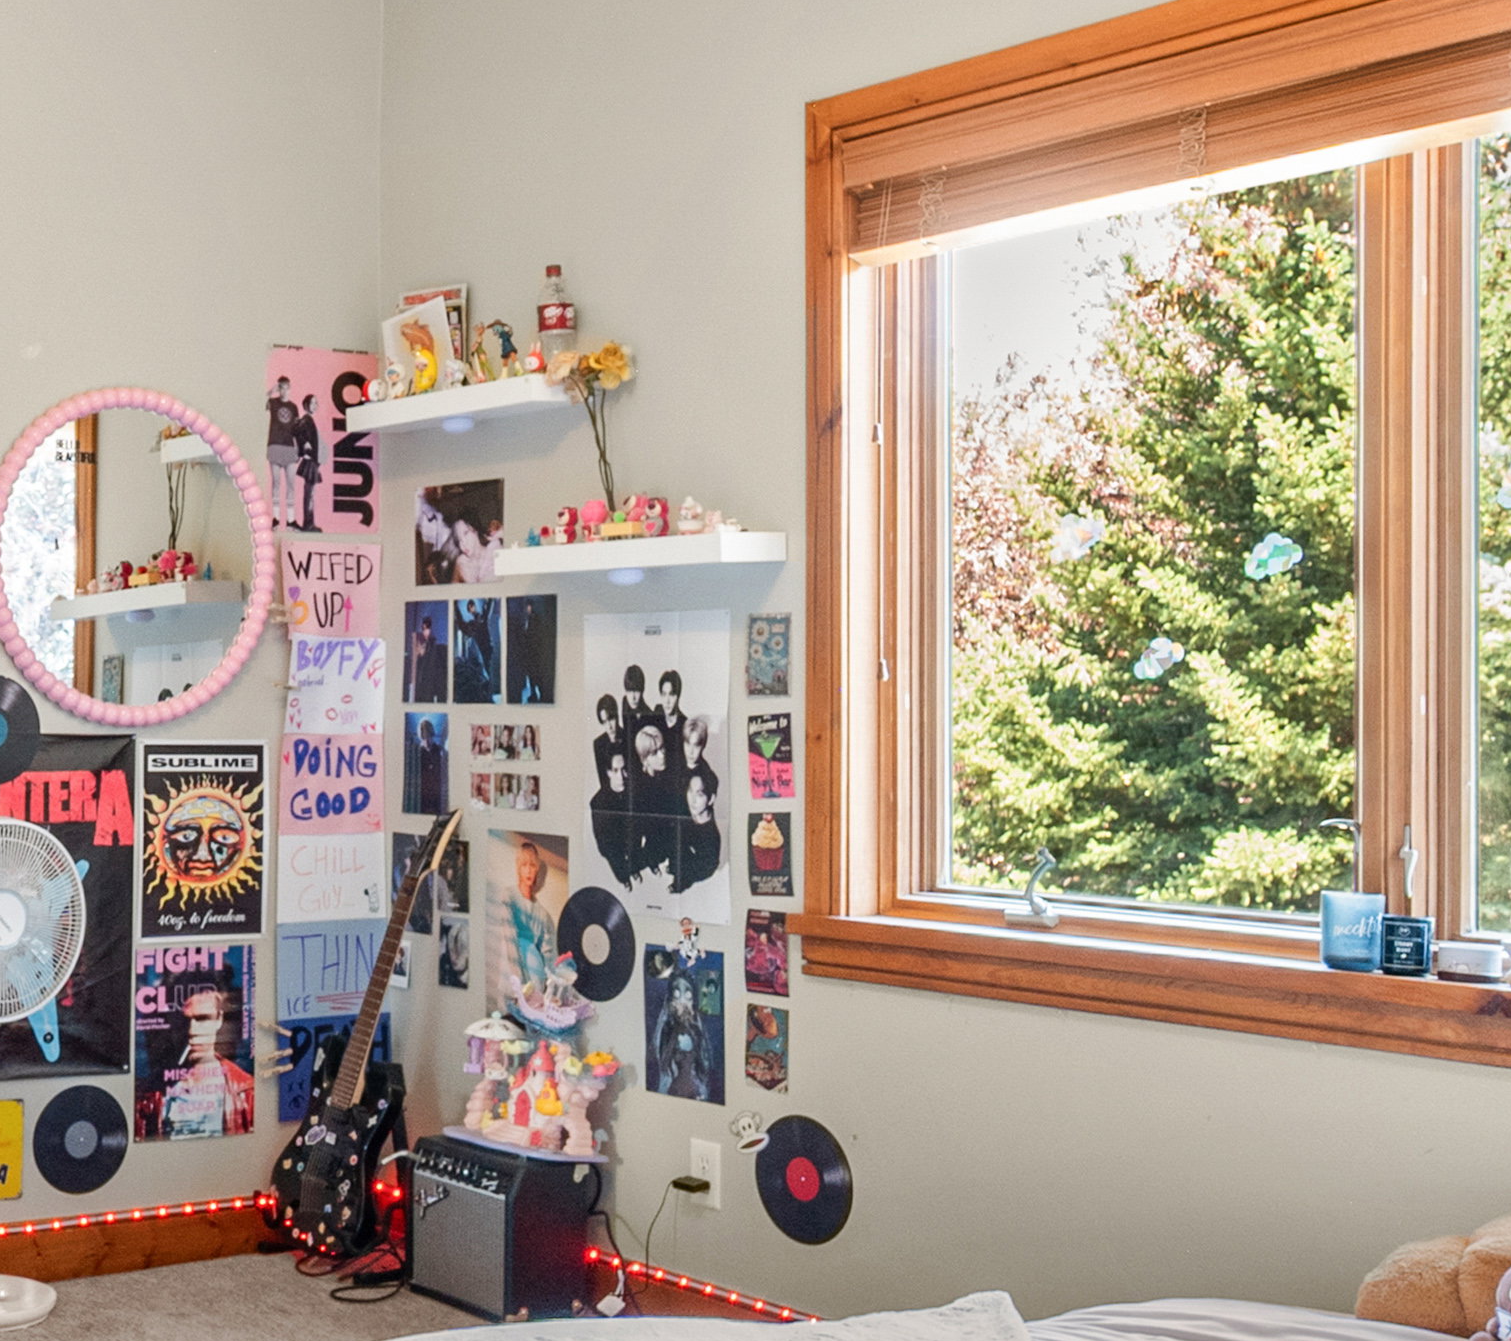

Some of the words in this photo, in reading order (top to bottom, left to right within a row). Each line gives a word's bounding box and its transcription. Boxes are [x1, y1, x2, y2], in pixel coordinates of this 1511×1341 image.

[288, 550, 374, 585] WIFED
[313, 591, 346, 629] UP
[151, 757, 255, 769] SUBLIME
[289, 785, 371, 821] GOOD
[189, 912, 201, 925] to
[136, 945, 228, 975] FIGHT
[282, 933, 374, 993] THIN
[287, 994, 312, 1017] ICE
